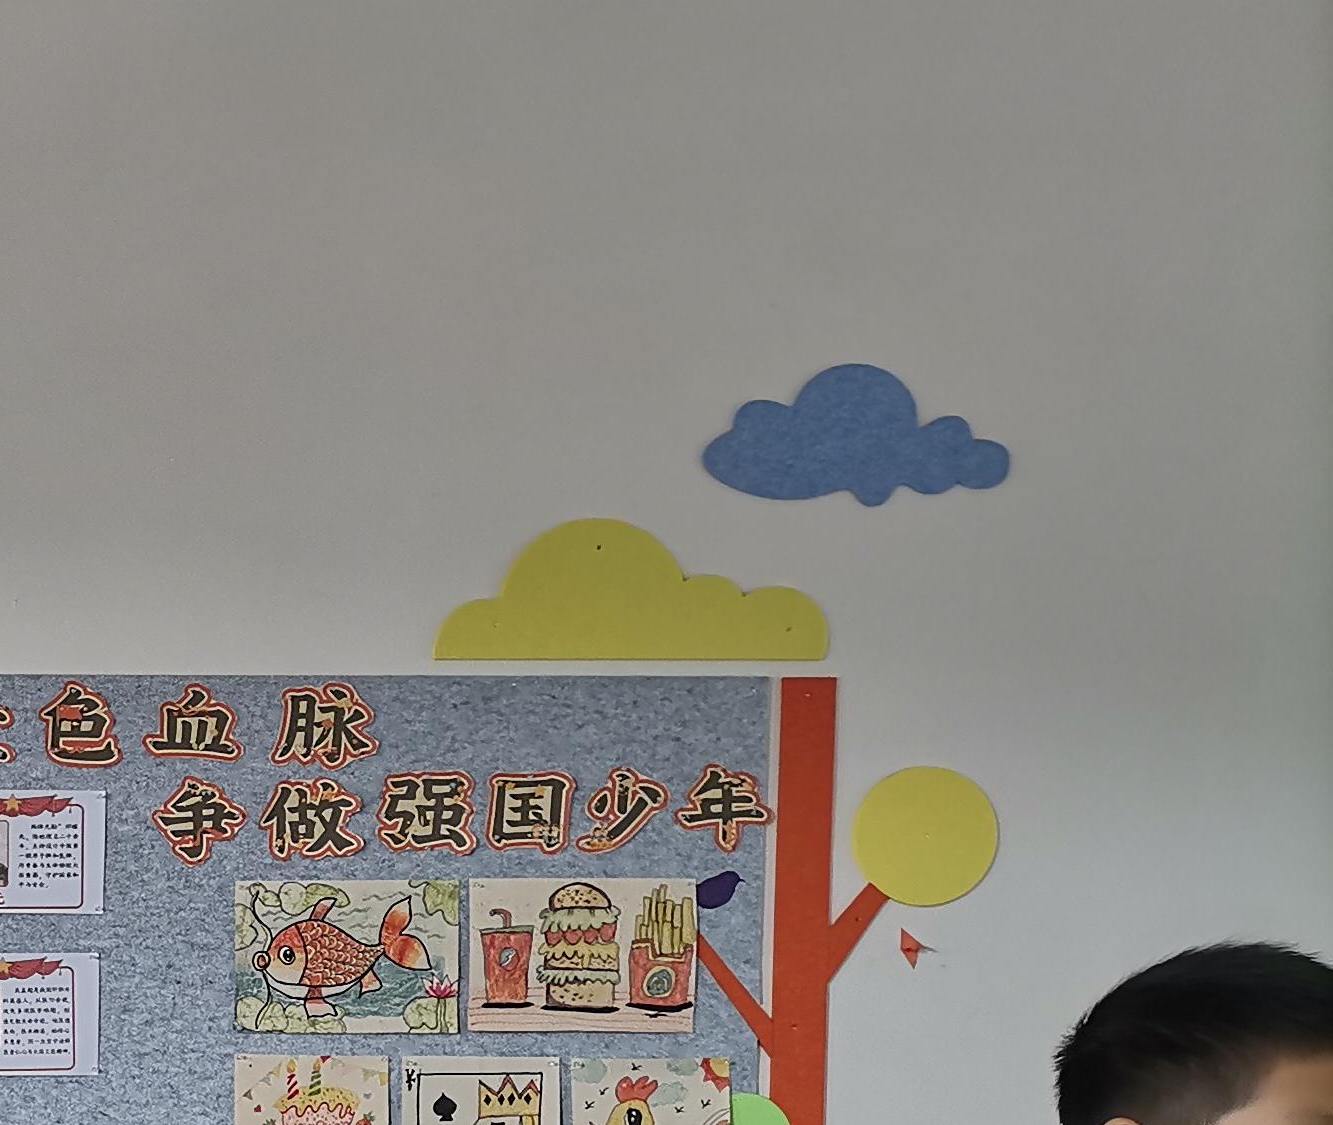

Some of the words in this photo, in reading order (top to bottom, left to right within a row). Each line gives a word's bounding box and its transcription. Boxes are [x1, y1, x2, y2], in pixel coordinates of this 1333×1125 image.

[158, 768, 766, 860] 争做强国少年
